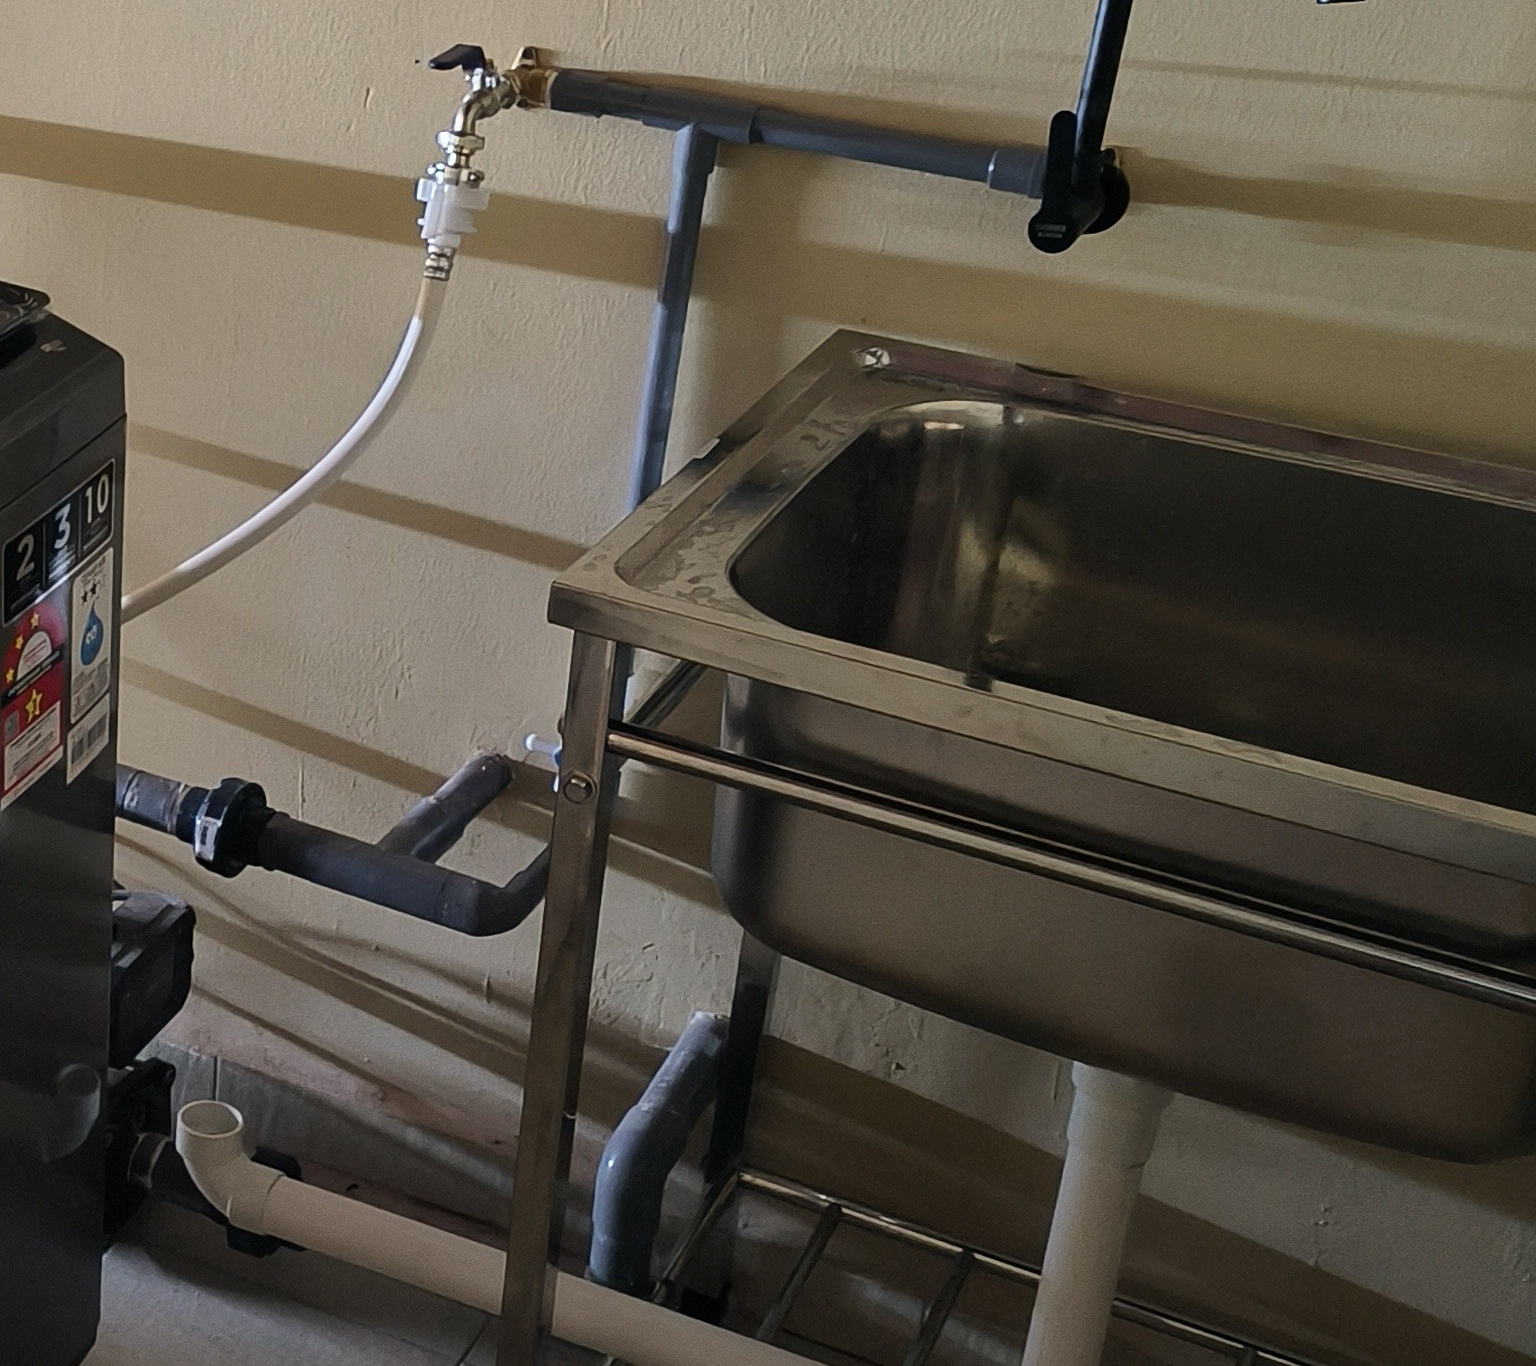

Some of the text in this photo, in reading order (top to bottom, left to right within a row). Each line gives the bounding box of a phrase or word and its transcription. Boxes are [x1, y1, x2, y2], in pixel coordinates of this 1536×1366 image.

[84, 474, 109, 524] 10
[54, 503, 71, 549] 3
[16, 535, 35, 581] 2
